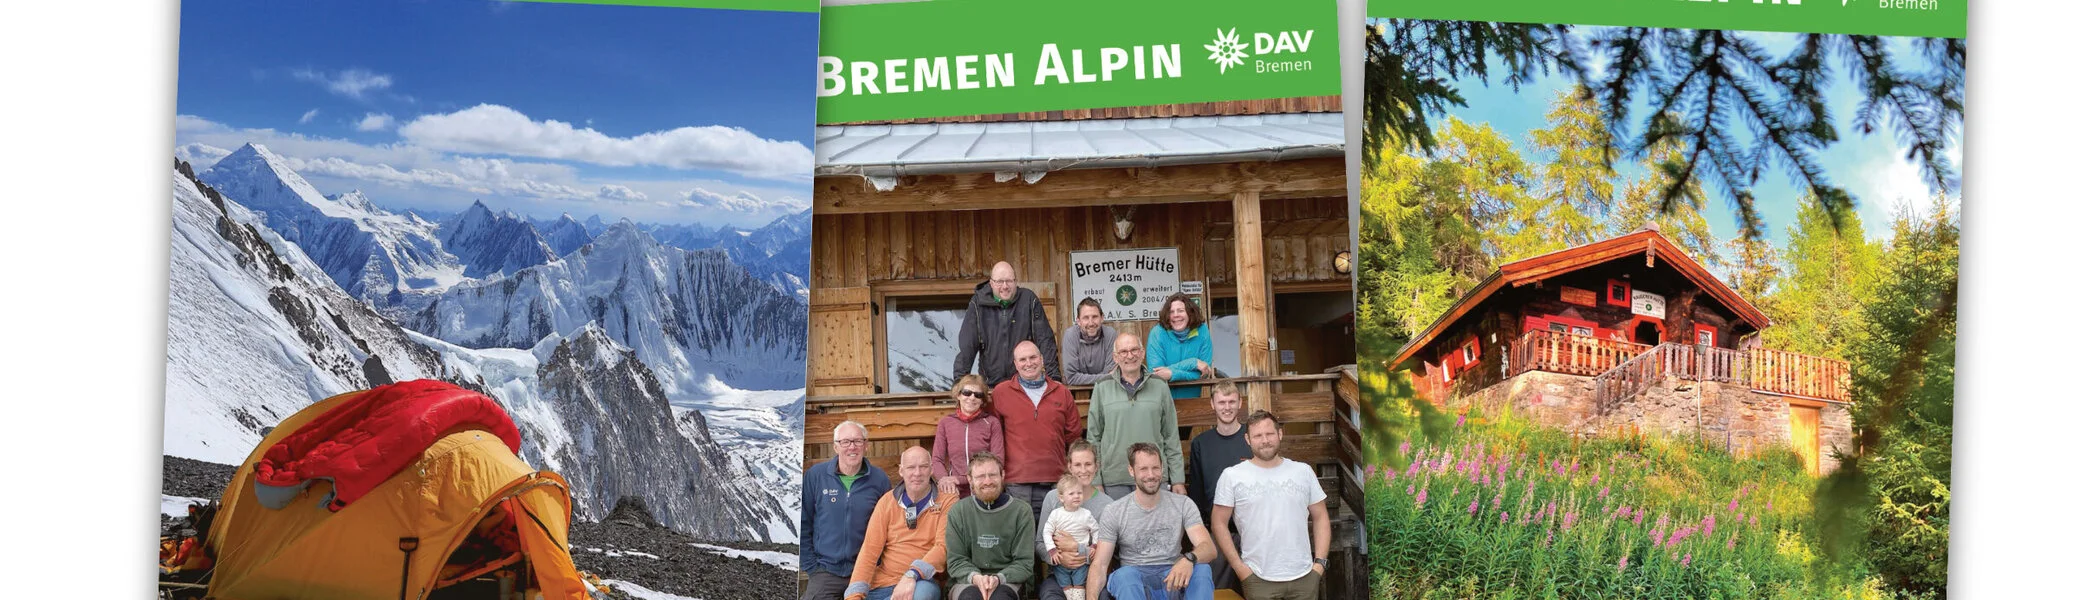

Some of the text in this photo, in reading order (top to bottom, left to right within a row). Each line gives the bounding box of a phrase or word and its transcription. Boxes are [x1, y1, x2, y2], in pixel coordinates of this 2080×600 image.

[1254, 29, 1314, 55] DAV
[1255, 60, 1312, 73] Bremen
[1075, 254, 1175, 278] Bremer Hütte
